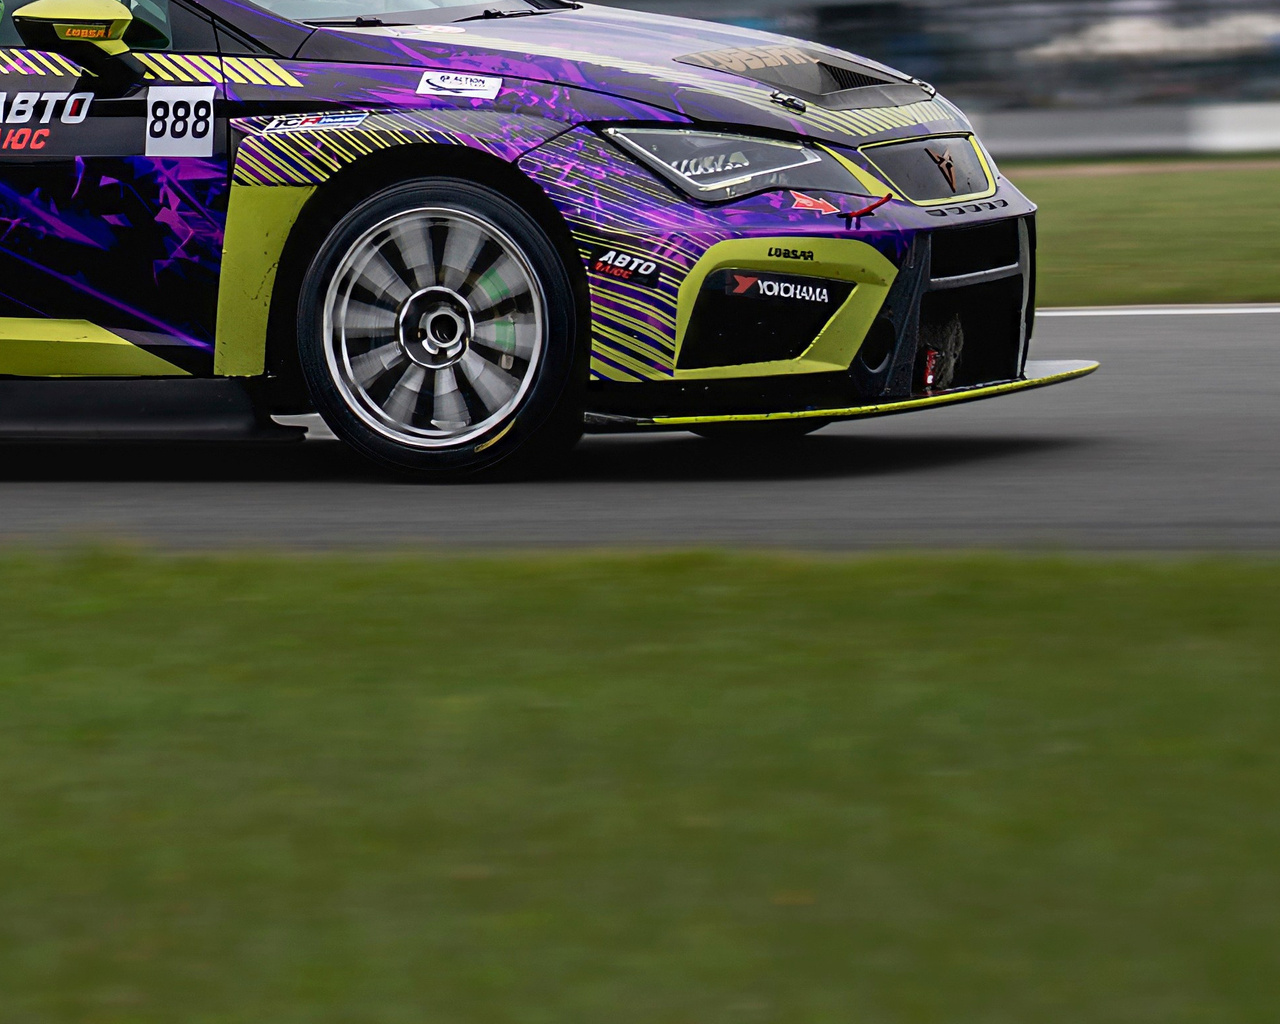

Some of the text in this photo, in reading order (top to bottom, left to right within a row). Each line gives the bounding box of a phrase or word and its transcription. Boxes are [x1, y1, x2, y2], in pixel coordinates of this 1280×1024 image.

[149, 100, 211, 139] 888
[599, 250, 657, 275] АВТО
[768, 247, 814, 261] LUBSAR
[757, 279, 829, 303] YOKOHAMA
